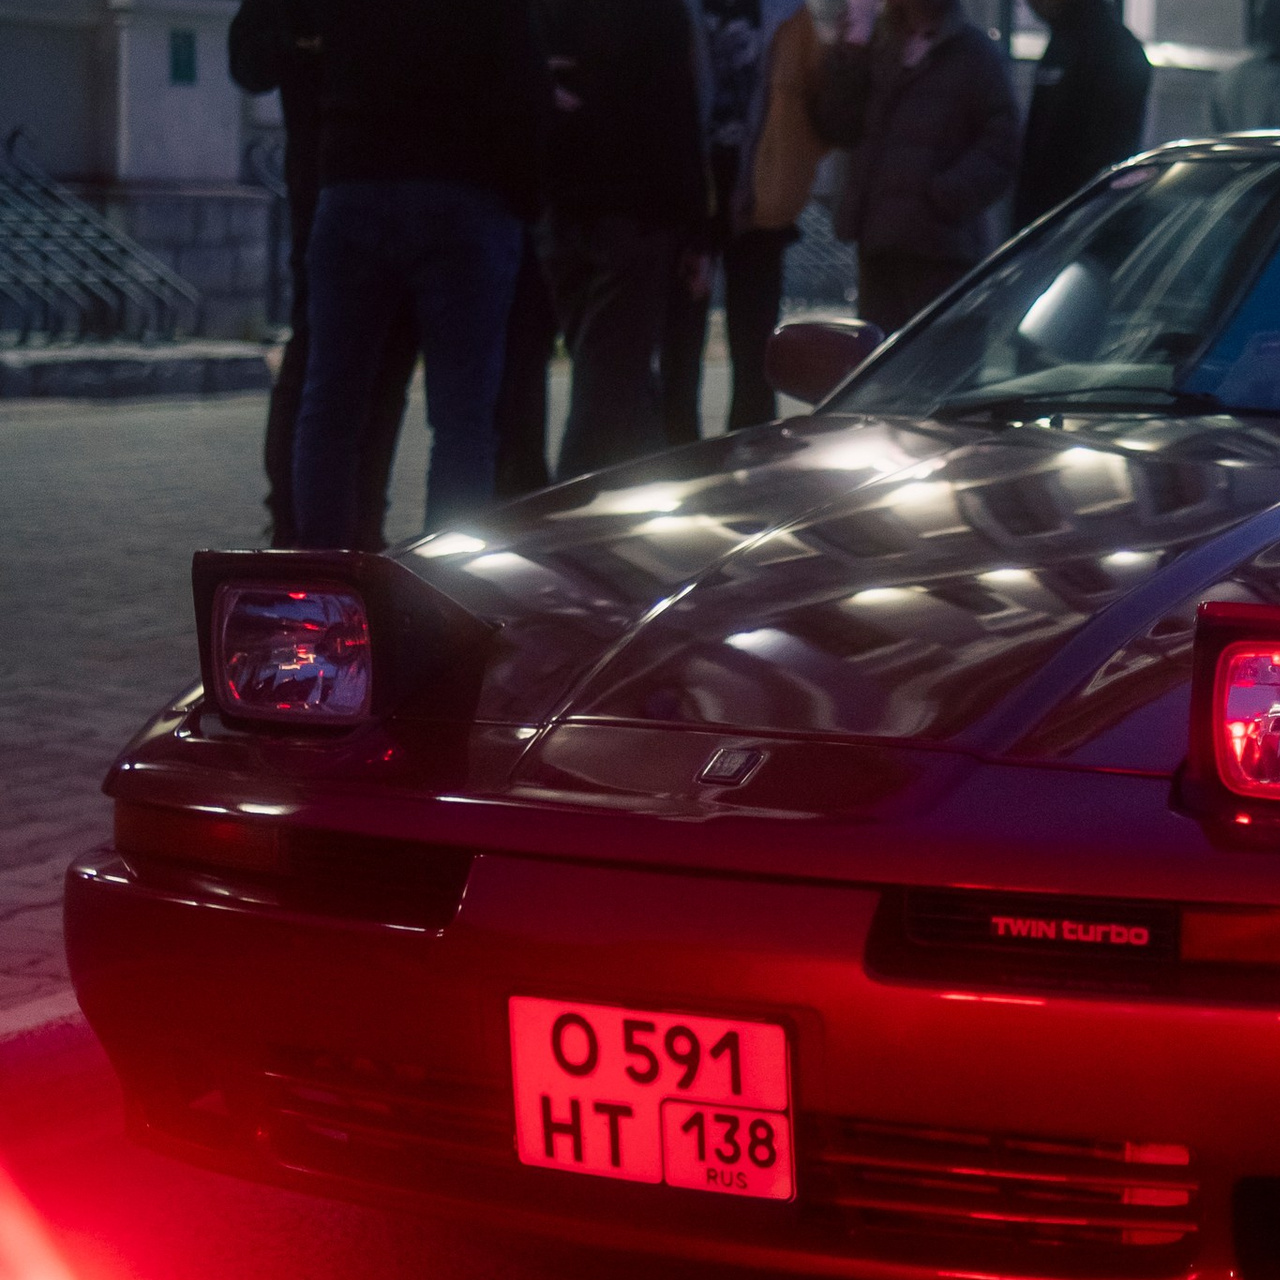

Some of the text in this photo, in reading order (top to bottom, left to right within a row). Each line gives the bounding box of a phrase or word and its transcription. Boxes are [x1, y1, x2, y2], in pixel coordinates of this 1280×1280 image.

[992, 916, 1148, 946] TWIN turbo
[623, 1019, 742, 1096] 591
[681, 1112, 776, 1169] 138
[706, 1167, 747, 1189] RUS
